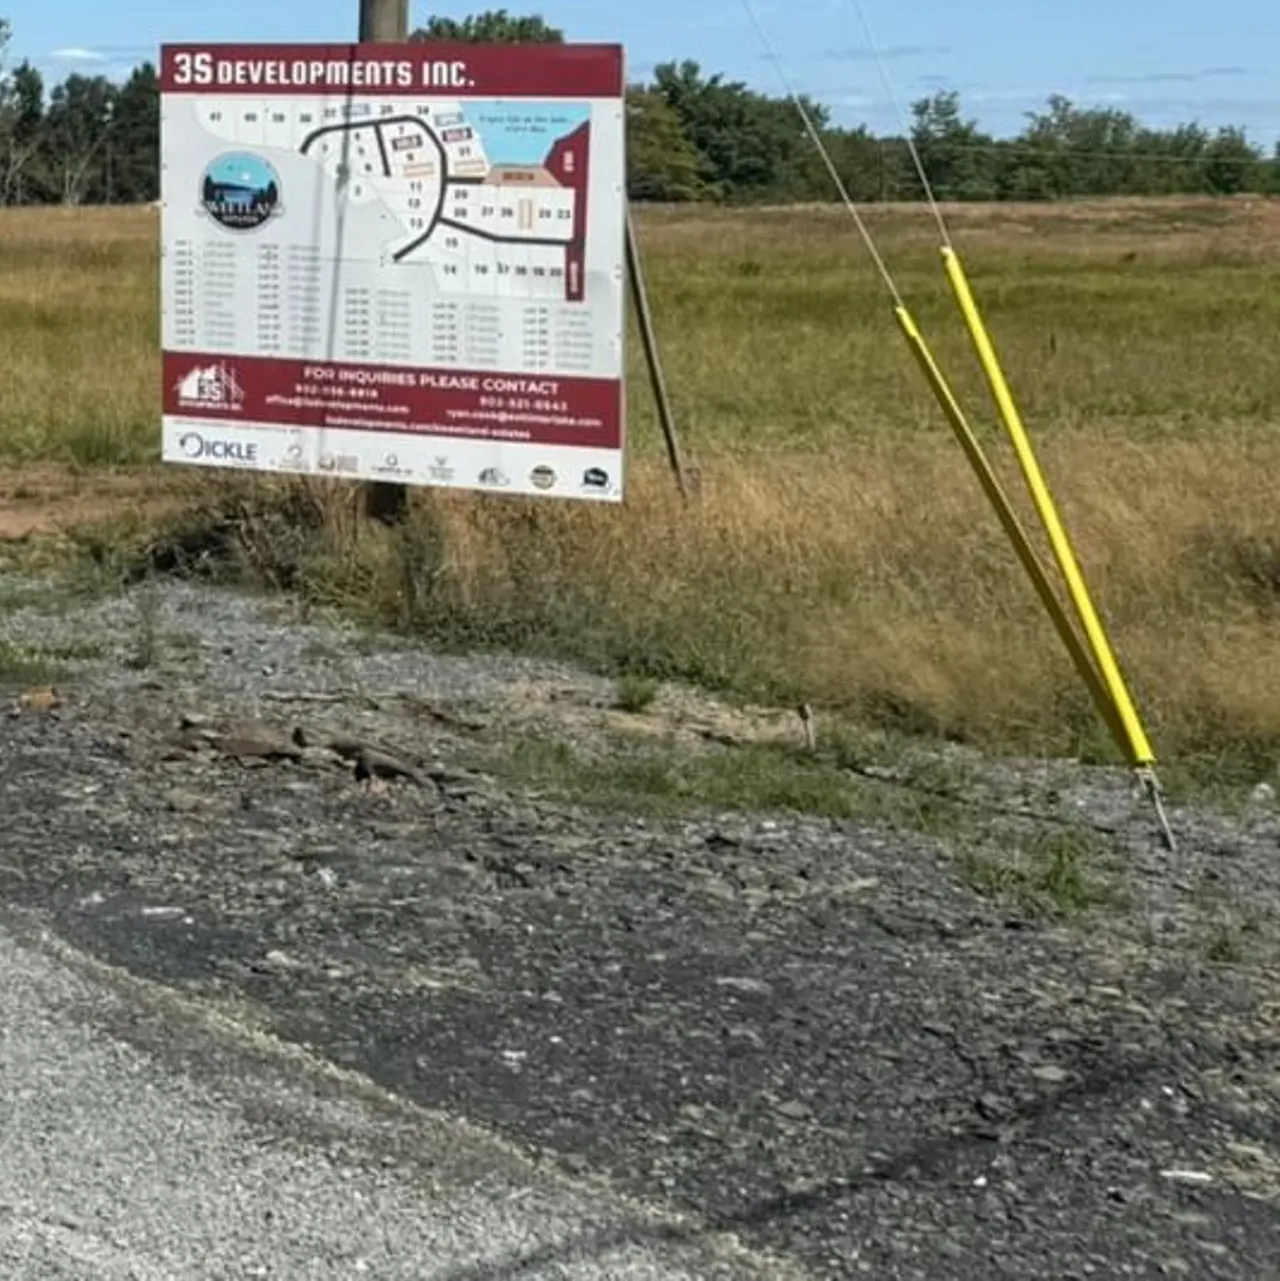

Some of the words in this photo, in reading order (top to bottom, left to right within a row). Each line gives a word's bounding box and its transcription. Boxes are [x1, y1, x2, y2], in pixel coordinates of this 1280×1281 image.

[173, 51, 214, 85] 3S
[217, 60, 413, 86] DEVELOPMENTS
[421, 60, 476, 87] INC.
[303, 366, 335, 380] FOR
[338, 369, 417, 387] INQUIRIES
[420, 373, 479, 392] PLEASE
[482, 377, 560, 396] CONTACT
